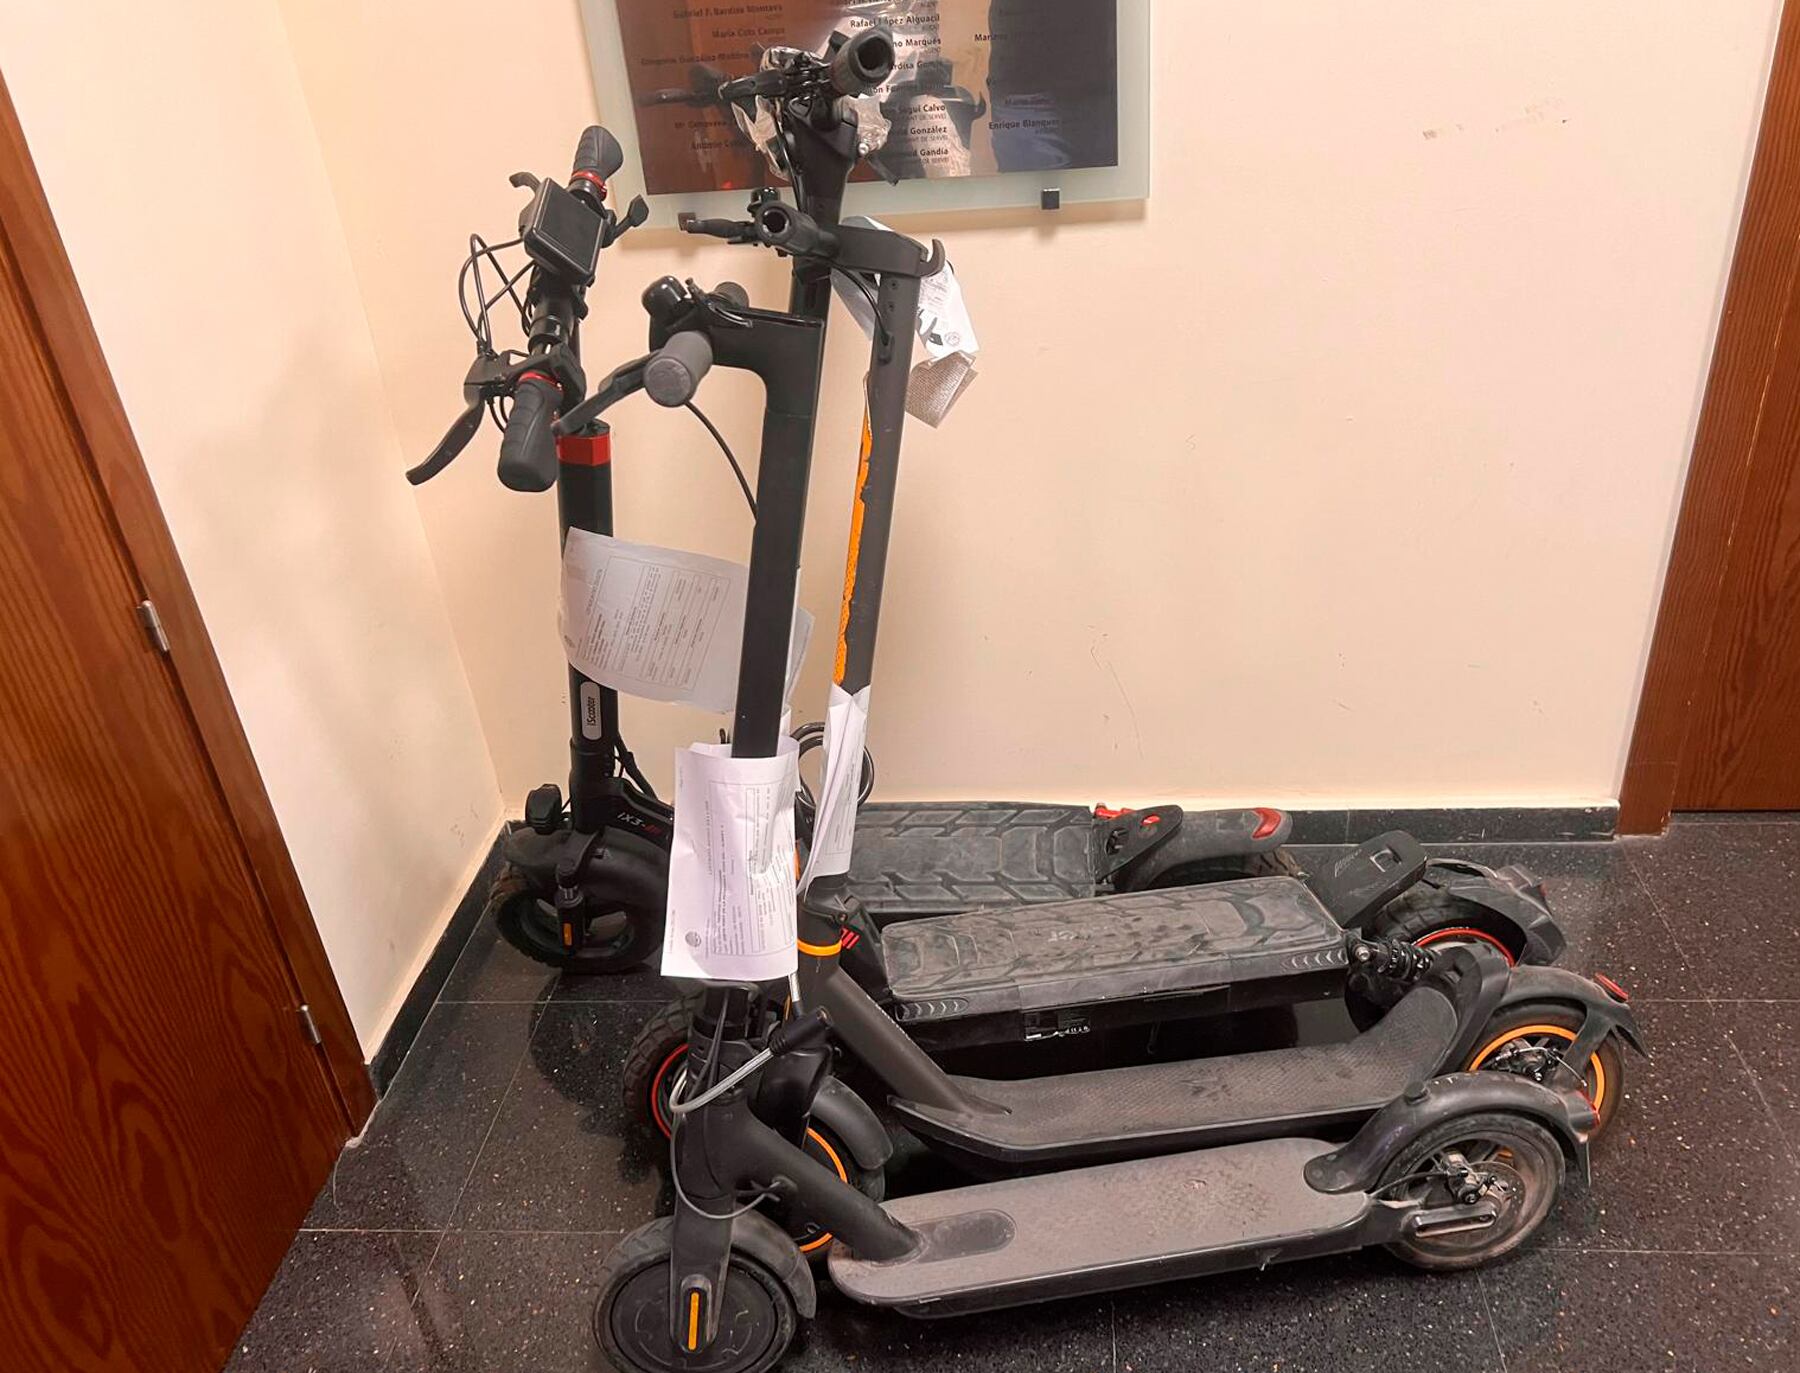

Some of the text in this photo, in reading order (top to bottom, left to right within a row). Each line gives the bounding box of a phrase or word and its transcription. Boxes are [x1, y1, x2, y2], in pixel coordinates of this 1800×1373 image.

[849, 17, 877, 28] Rafael
[906, 13, 940, 25] Alguacil
[922, 103, 946, 112] Calvo
[910, 125, 948, 135] González
[988, 120, 1021, 131] Enrique
[919, 146, 949, 157] Gandía
